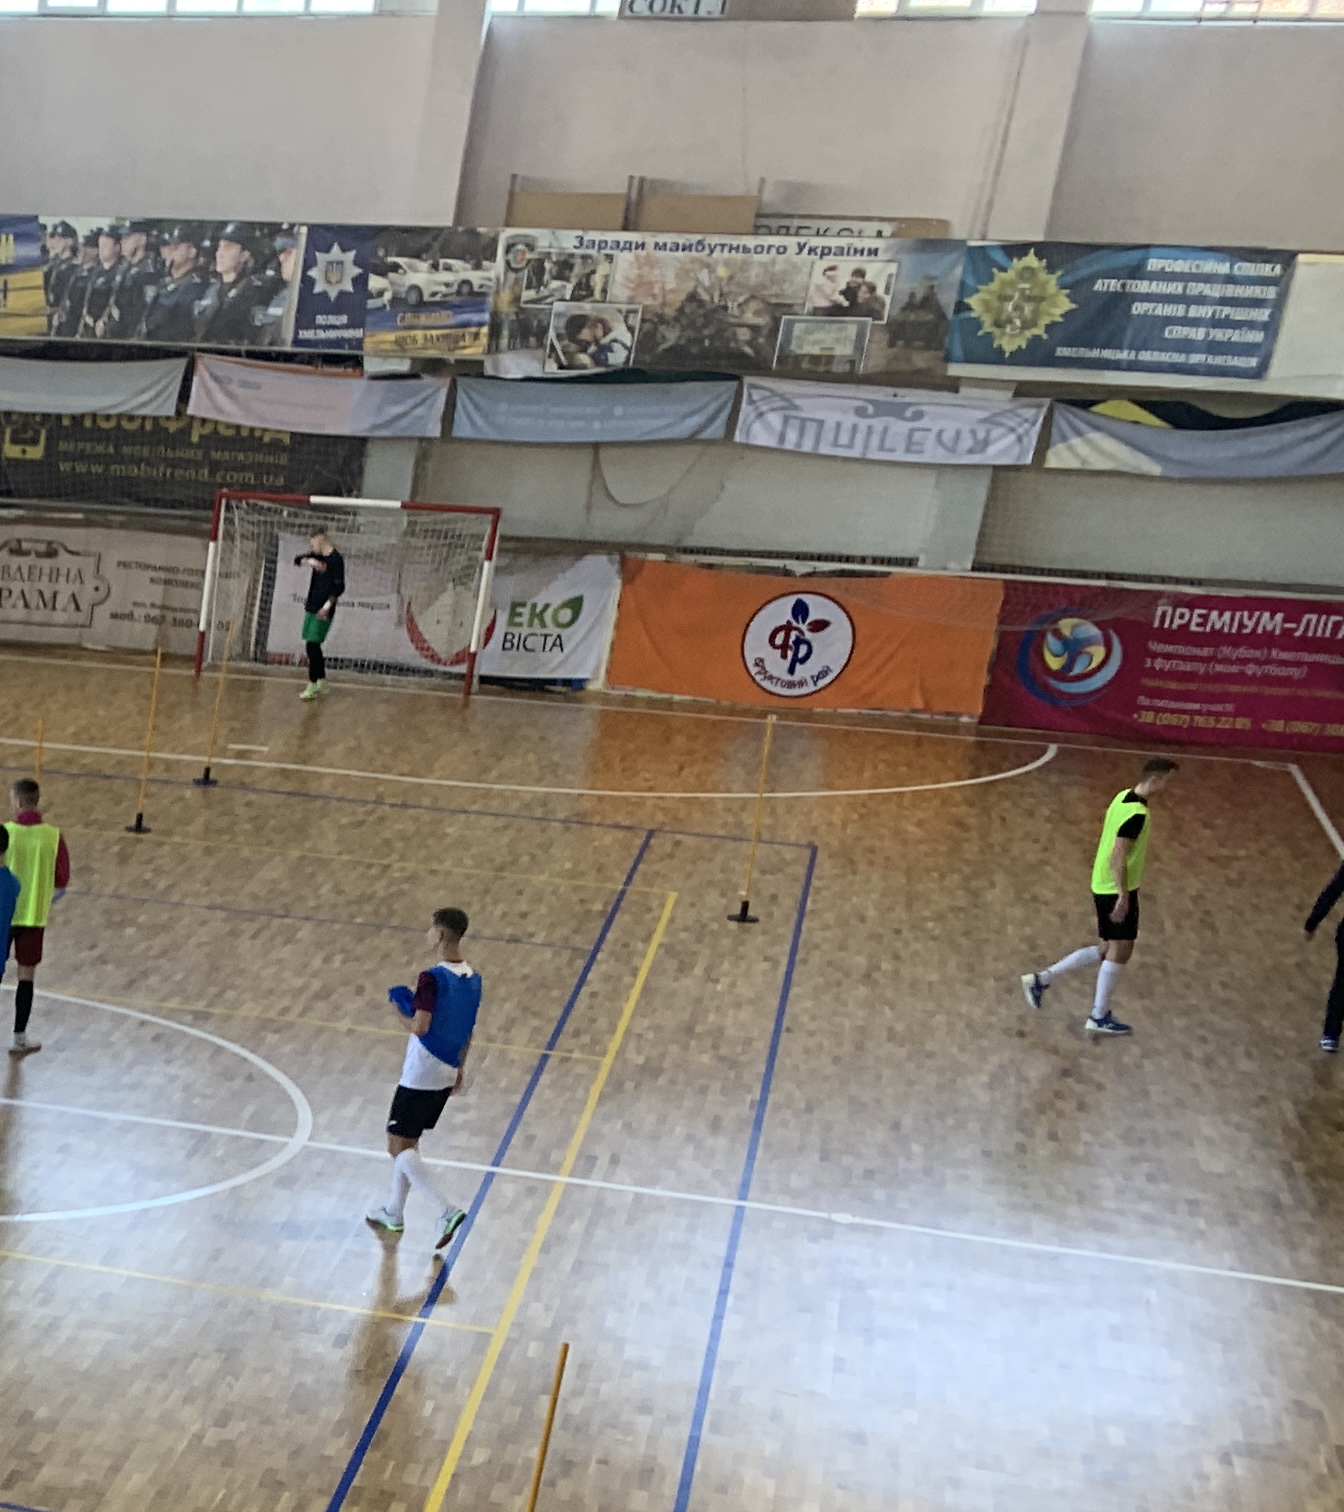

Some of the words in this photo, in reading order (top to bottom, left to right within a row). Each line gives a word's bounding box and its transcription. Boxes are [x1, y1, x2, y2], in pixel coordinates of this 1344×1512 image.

[573, 236, 646, 253] Заради
[654, 238, 787, 256] майбутнього
[795, 241, 879, 259] України
[502, 632, 564, 653] ВІСТА
[810, 665, 834, 688] рай
